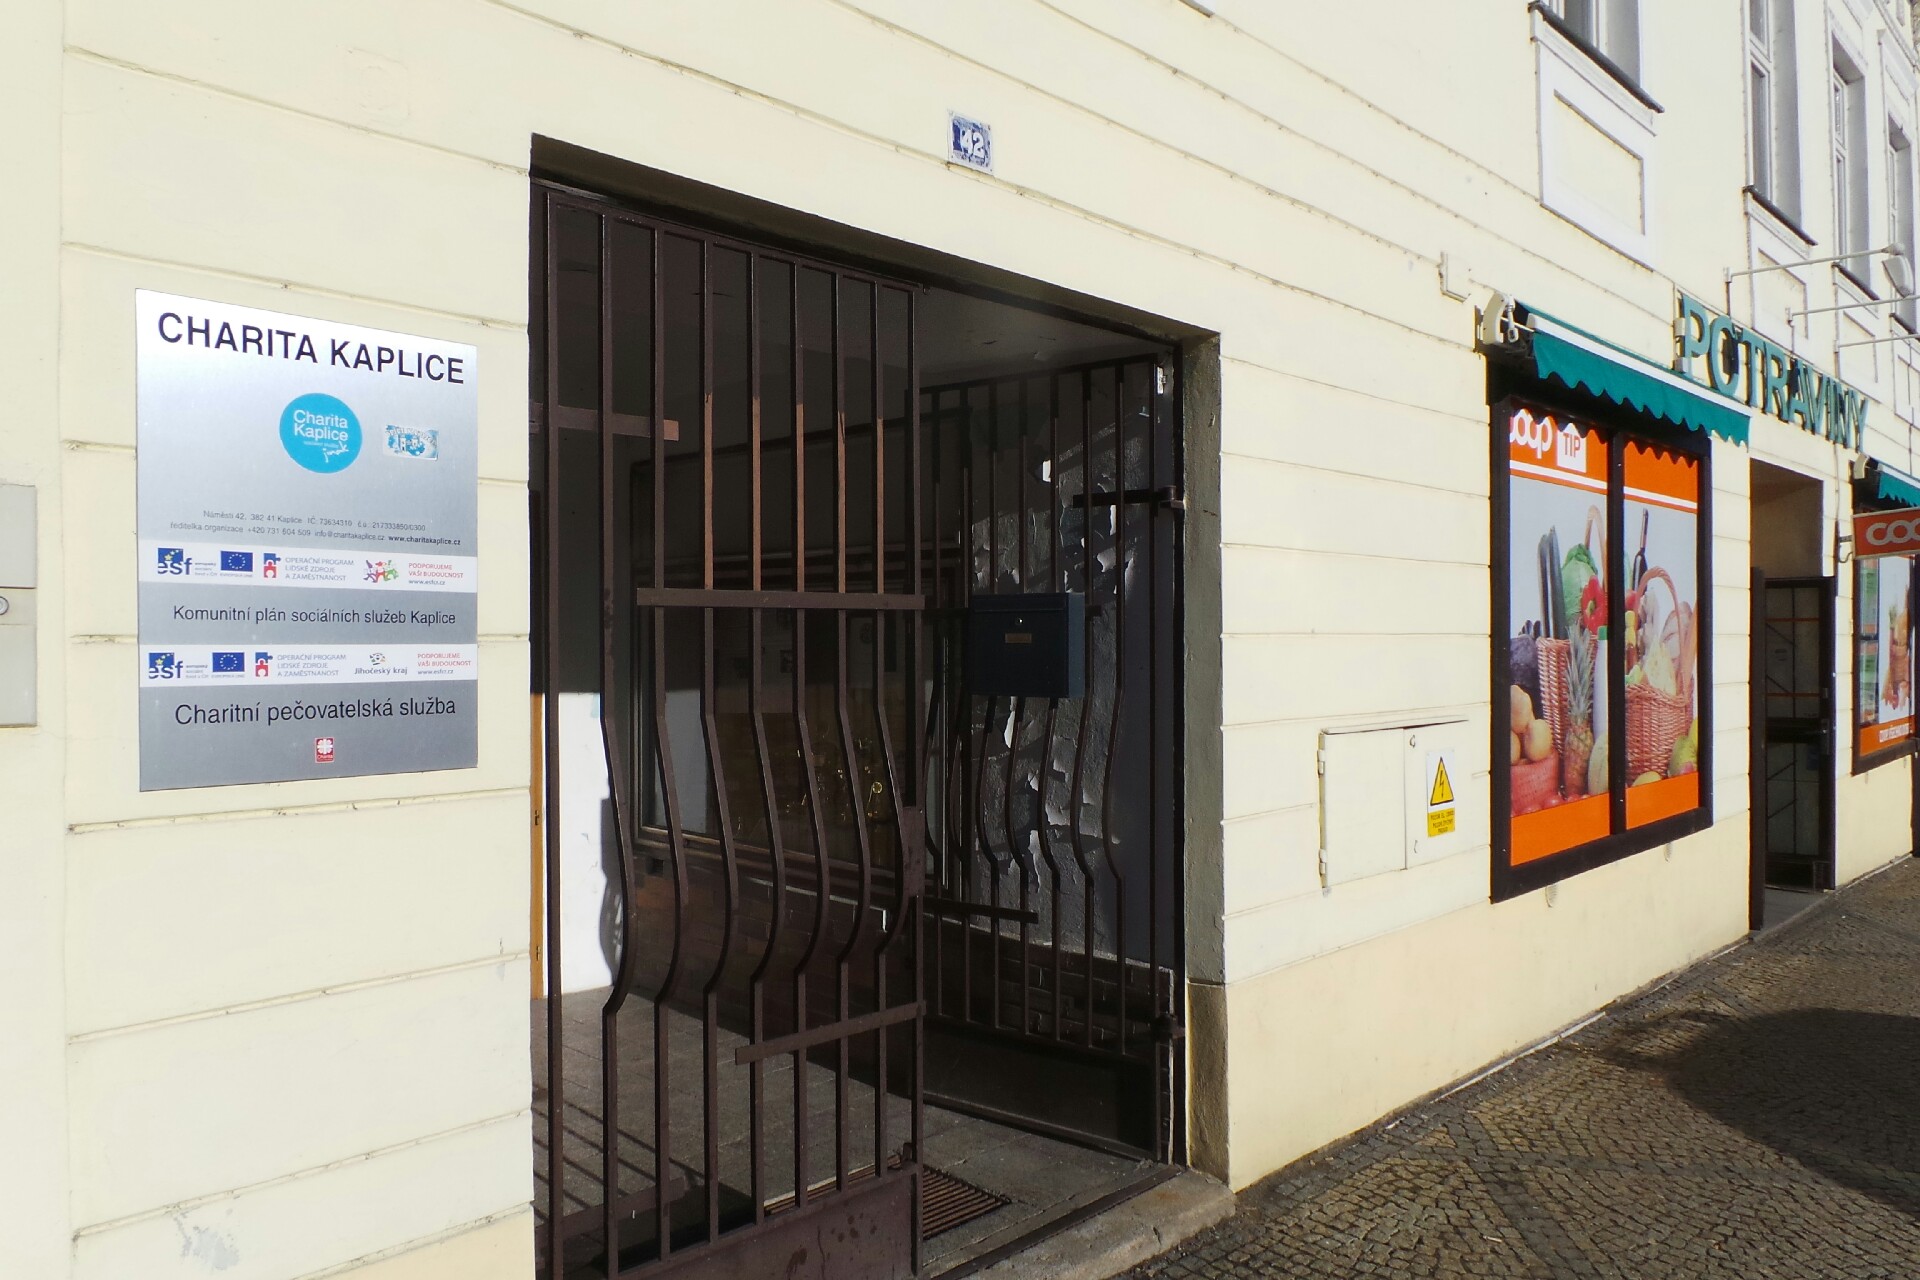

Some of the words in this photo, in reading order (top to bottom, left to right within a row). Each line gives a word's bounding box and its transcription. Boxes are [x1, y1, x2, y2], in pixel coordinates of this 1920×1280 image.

[960, 129, 985, 159] 42
[158, 312, 318, 364] CHARITA
[331, 338, 464, 384] KAPLICE
[1680, 291, 1867, 453] POTRAVINY
[293, 409, 348, 429] Charita
[294, 423, 349, 441] Kaplice
[1563, 432, 1581, 458] TIP
[251, 513, 264, 522] 382
[267, 514, 275, 522] 41
[277, 515, 303, 525] Kaplice
[204, 523, 244, 533] organizace
[247, 526, 265, 535] +420
[267, 526, 280, 535] 731
[388, 534, 461, 546] www.charitakaplice.cz
[157, 557, 192, 576] esf
[285, 556, 320, 565] OPERAČNÍ
[321, 558, 354, 566] PROGRAM
[408, 562, 453, 570] PODPORUJEME
[423, 571, 464, 579] BUDOUCNOST
[174, 605, 251, 621] Komunitní
[255, 607, 286, 624] plán
[291, 608, 360, 623] sociálních
[364, 608, 406, 624] služeb
[411, 610, 456, 627] Kaplice
[277, 653, 312, 661] OPERAČNÍ
[148, 660, 184, 679] esf
[393, 666, 408, 676] kraj
[175, 701, 261, 725] Charitní
[268, 697, 393, 726] pečovatelská
[399, 696, 456, 716] služba
